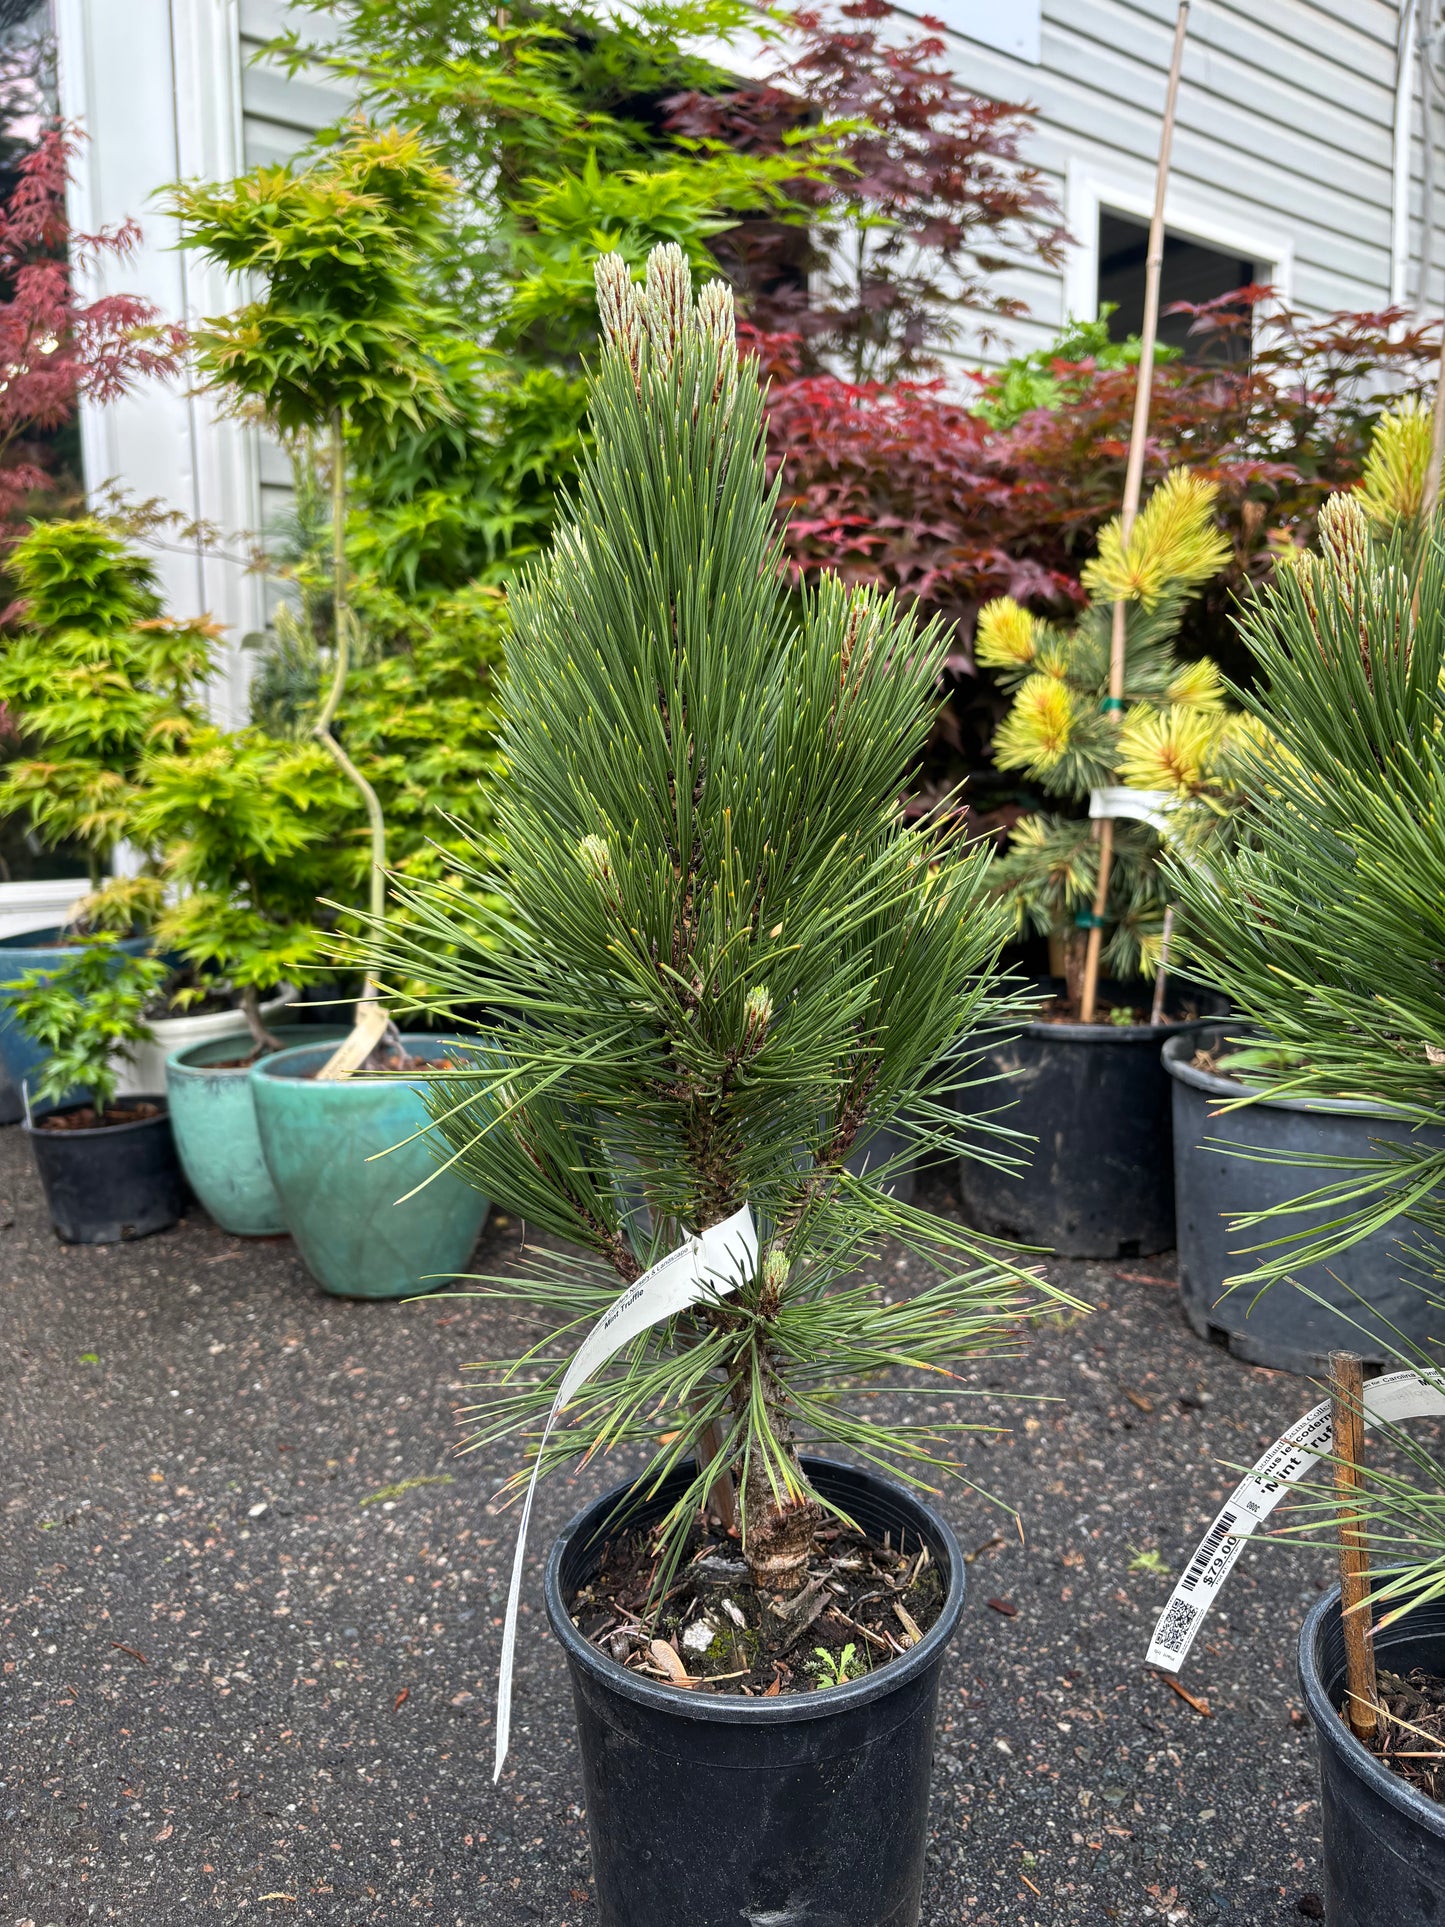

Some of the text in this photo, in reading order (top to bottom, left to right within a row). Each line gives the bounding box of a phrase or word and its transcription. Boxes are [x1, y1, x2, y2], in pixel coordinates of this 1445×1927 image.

[629, 1274, 651, 1295] Nursery
[656, 1247, 689, 1272] Landscape
[604, 1311, 619, 1330] Mint
[620, 1289, 645, 1313] Truffle
[1382, 1372, 1416, 1383] Carolina
[1254, 1457, 1282, 1485] Pnus
[1203, 1536, 1238, 1586] $79.00
